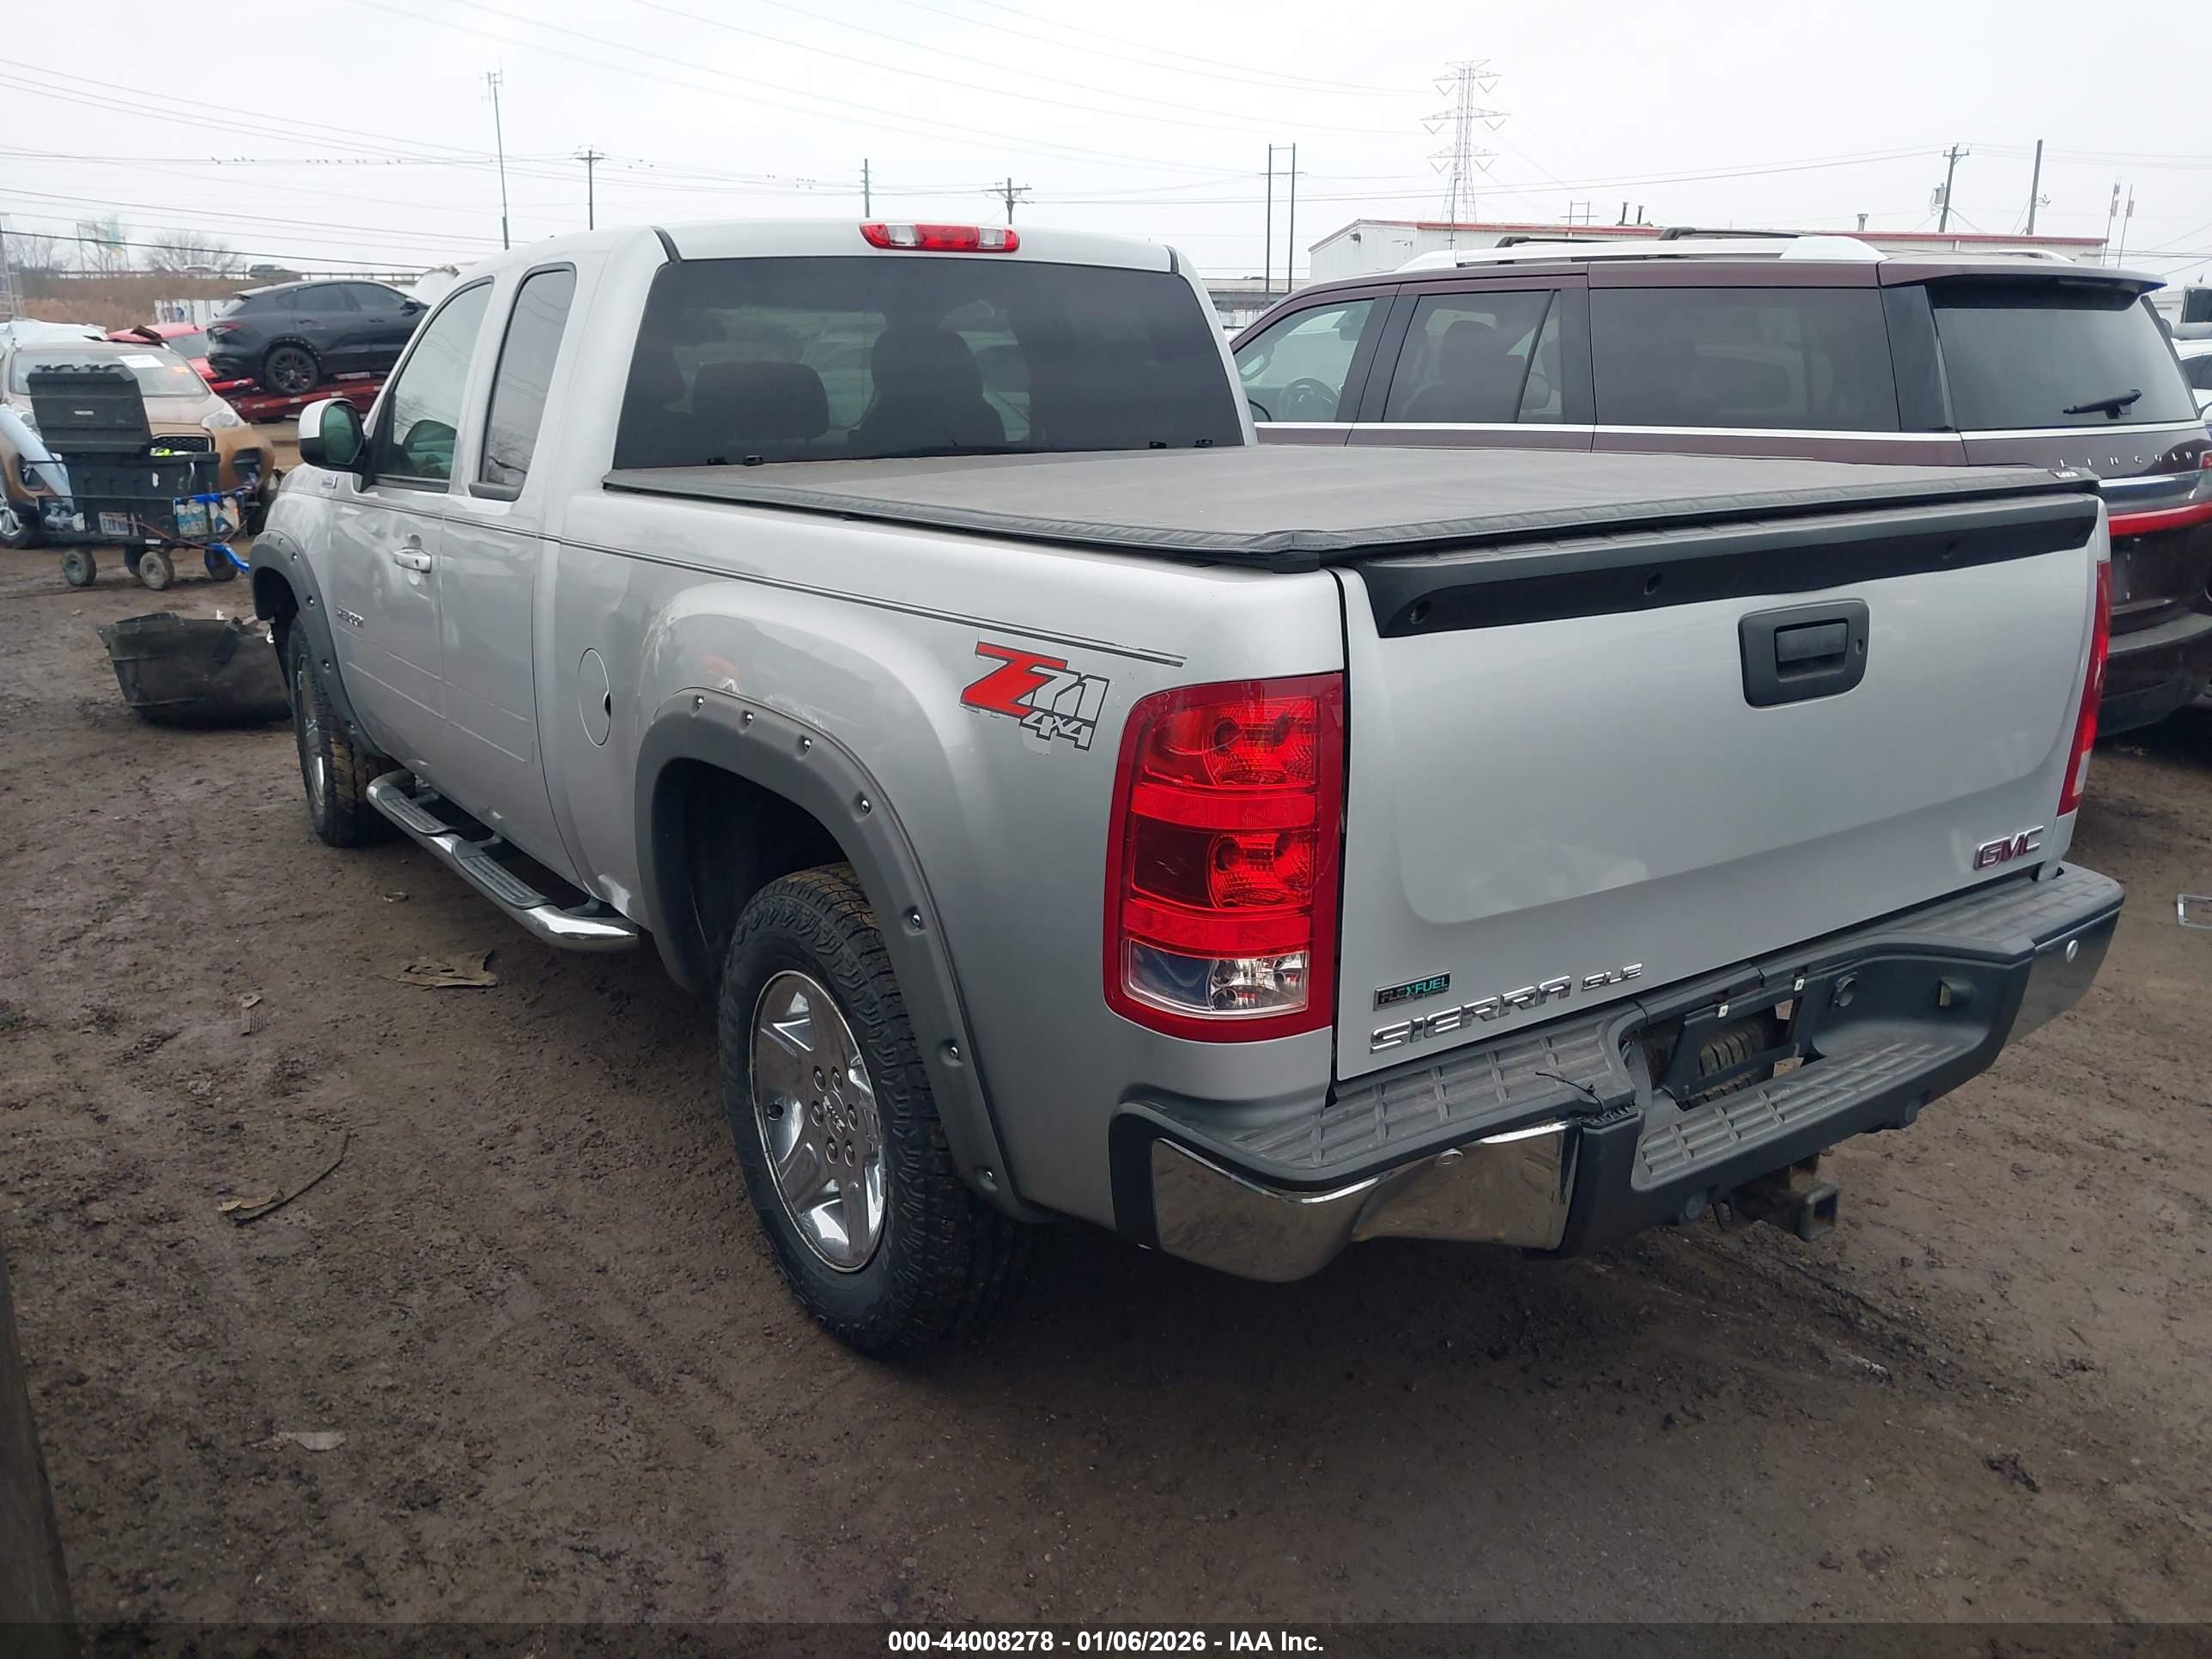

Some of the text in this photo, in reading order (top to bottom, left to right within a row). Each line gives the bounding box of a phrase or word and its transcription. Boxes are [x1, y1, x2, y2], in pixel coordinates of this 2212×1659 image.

[2059, 451, 2193, 468] LINCOLN
[960, 641, 1110, 723] Z71
[1974, 825, 2045, 871] GMC
[1370, 963, 1644, 1054] SIERRA SLE
